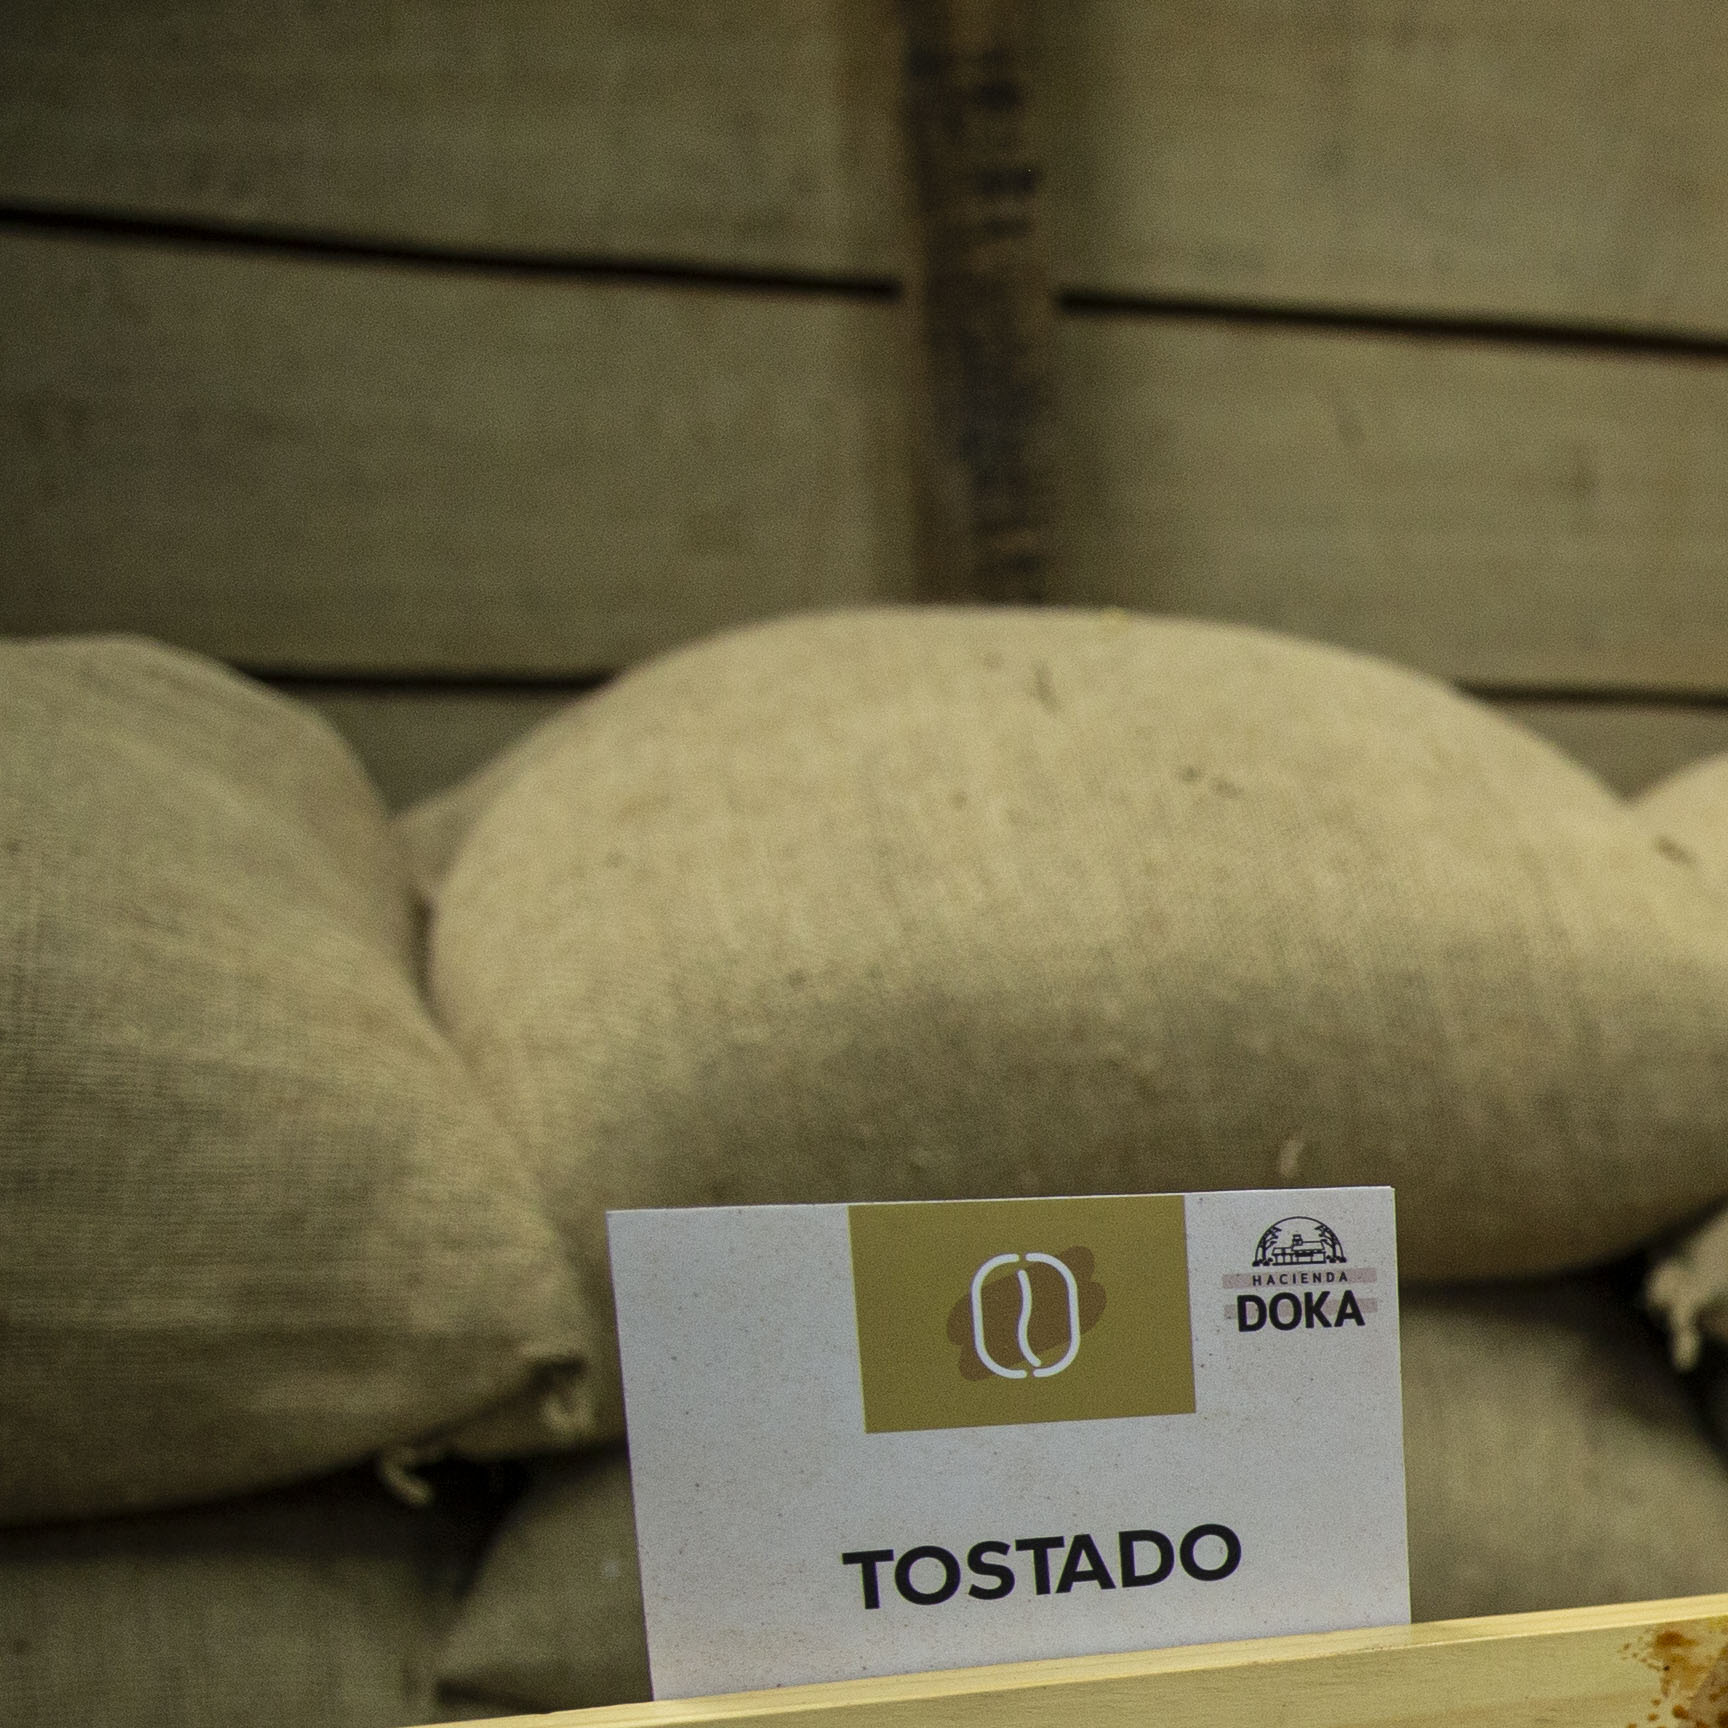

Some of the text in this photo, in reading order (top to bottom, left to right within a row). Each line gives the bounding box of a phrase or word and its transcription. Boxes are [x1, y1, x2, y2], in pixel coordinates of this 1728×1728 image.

[1252, 1271, 1349, 1287] HACIENDA
[1237, 1290, 1366, 1333] DOKA
[843, 1524, 1242, 1610] TOSTADO
